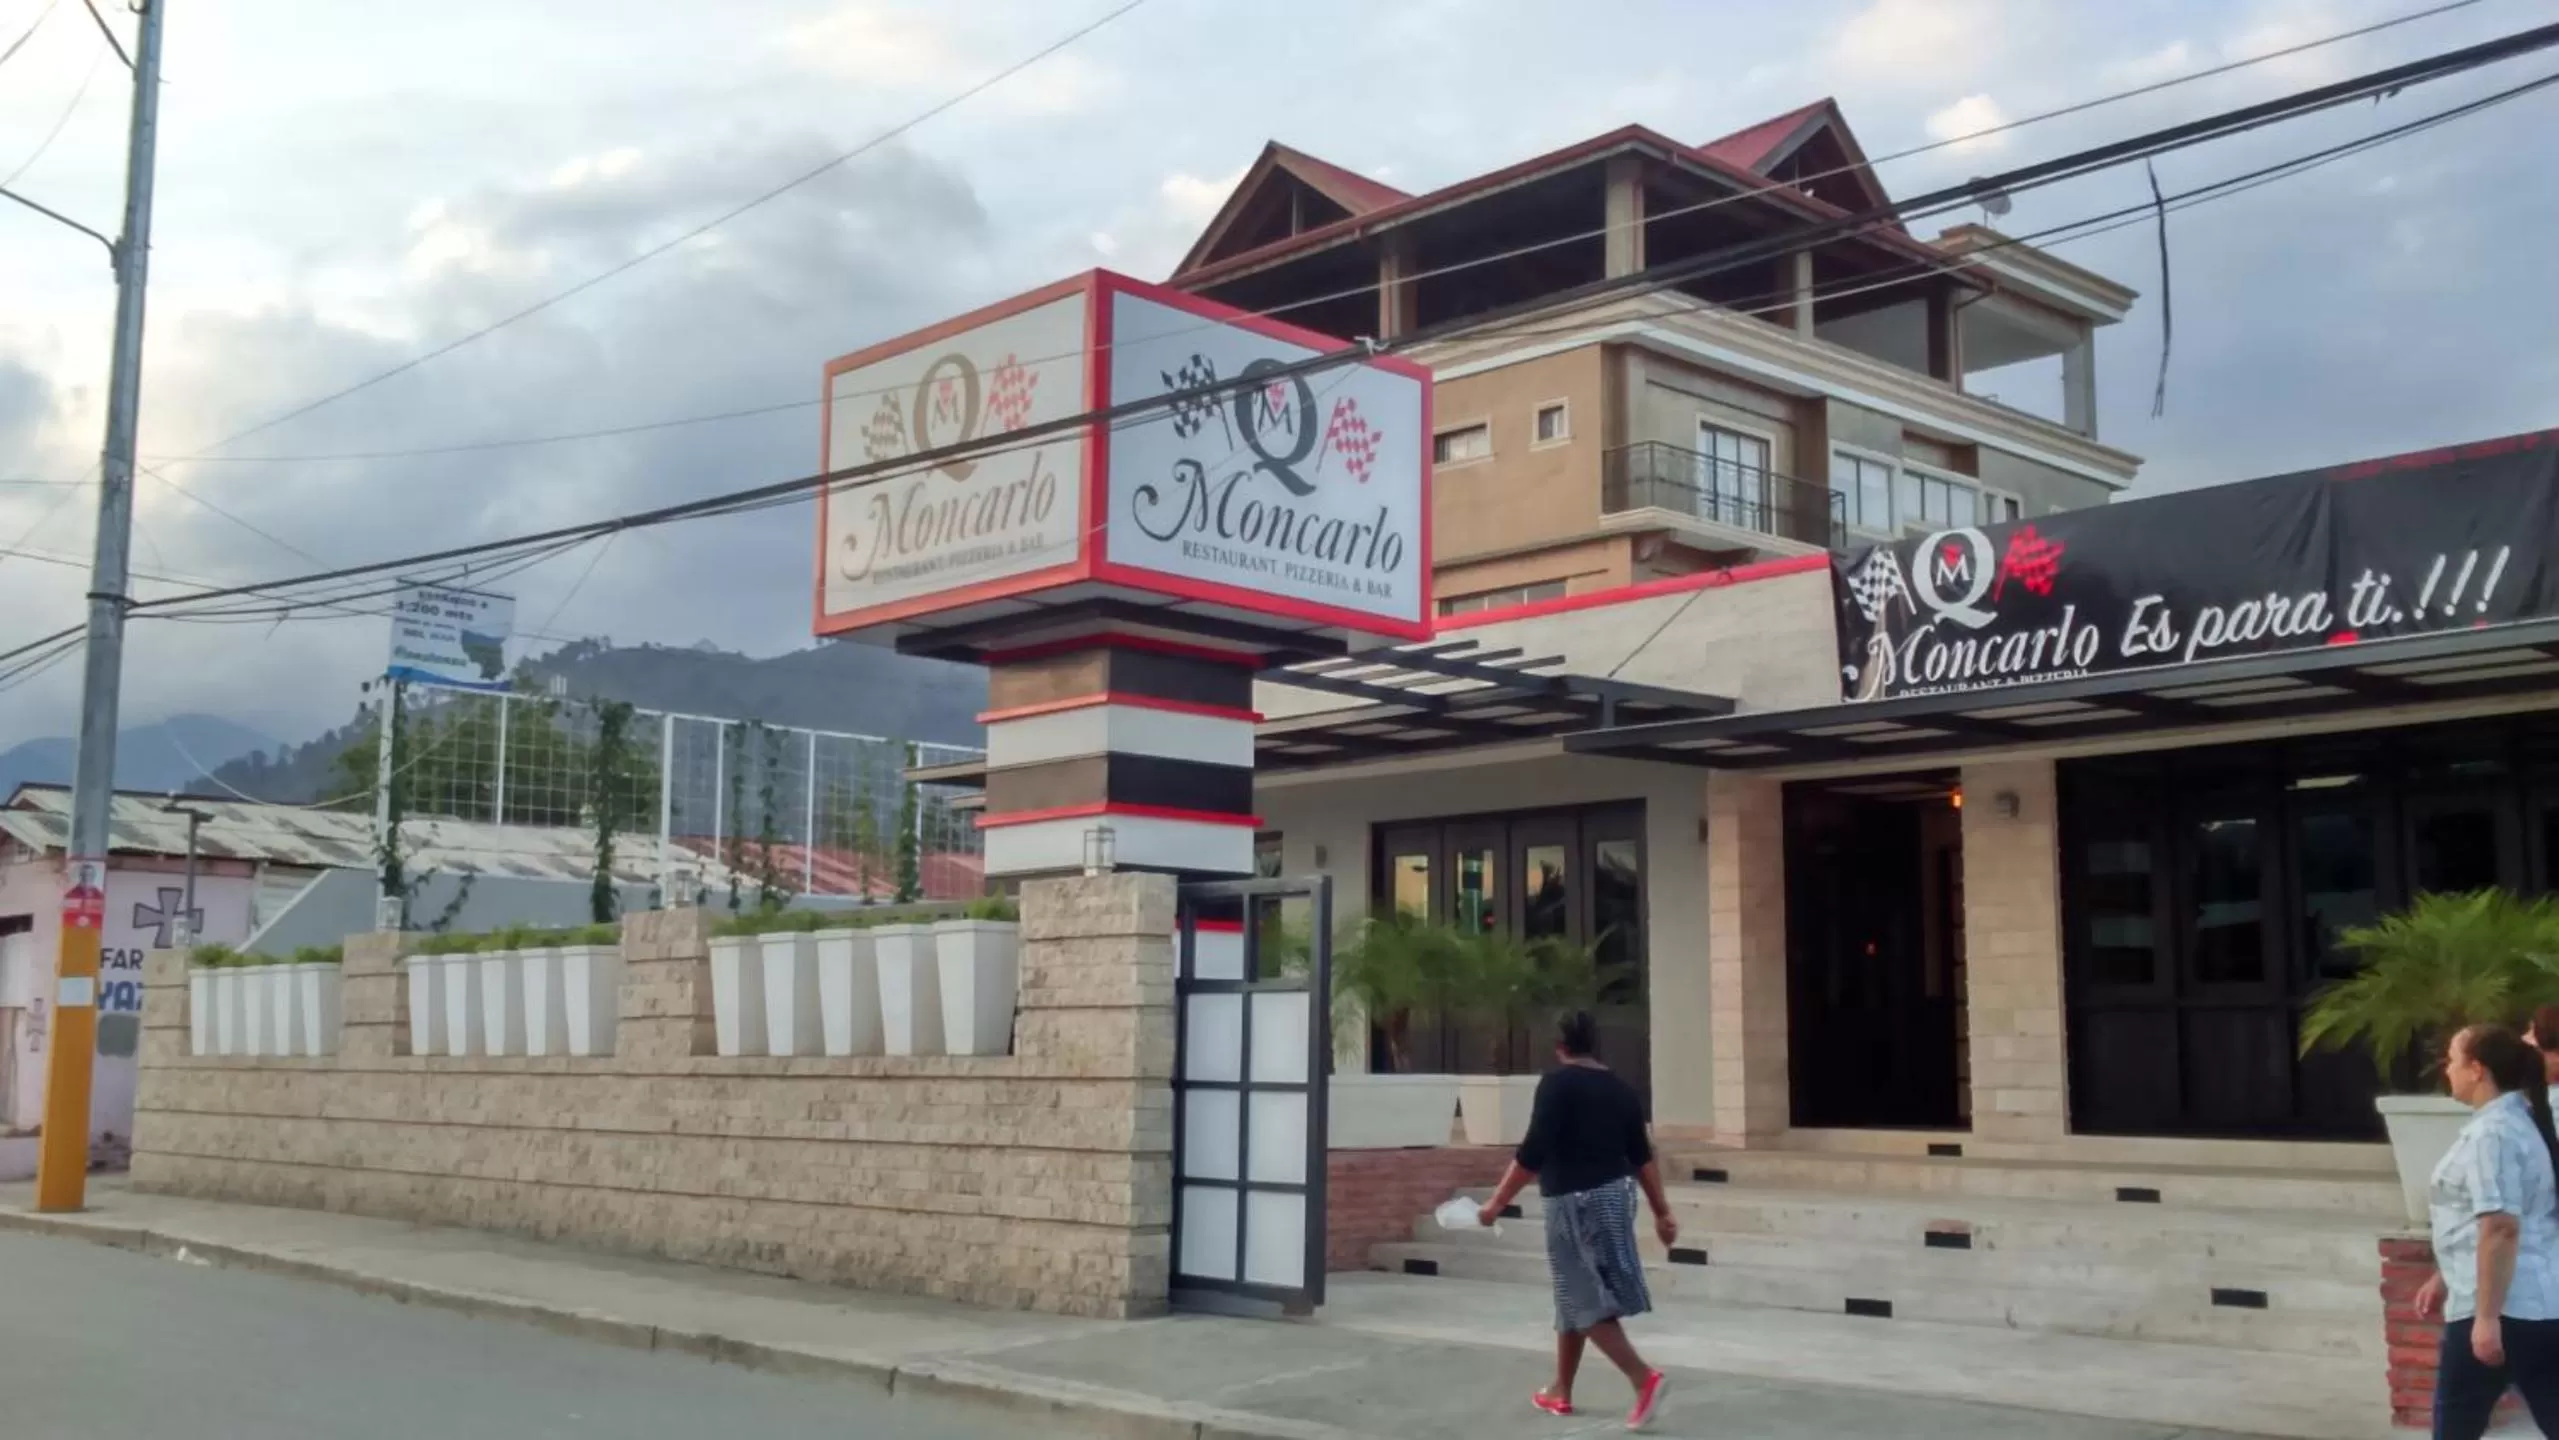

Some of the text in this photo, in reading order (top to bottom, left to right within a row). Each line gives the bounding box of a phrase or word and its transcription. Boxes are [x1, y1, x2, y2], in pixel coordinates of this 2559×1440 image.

[913, 353, 980, 482] Q
[1235, 358, 1317, 497] Q
[840, 450, 1056, 581] Moncarlo
[1132, 458, 1404, 574] Moncarlo
[1182, 540, 1279, 577] RESTAURANT
[1284, 562, 1350, 590] PIZZERIA
[1367, 577, 1394, 599] BAR
[1936, 553, 1971, 586] M
[1912, 527, 1998, 629] Q
[1842, 604, 2100, 702] Moncarlo
[2120, 595, 2181, 658] Es
[2184, 590, 2333, 662] para
